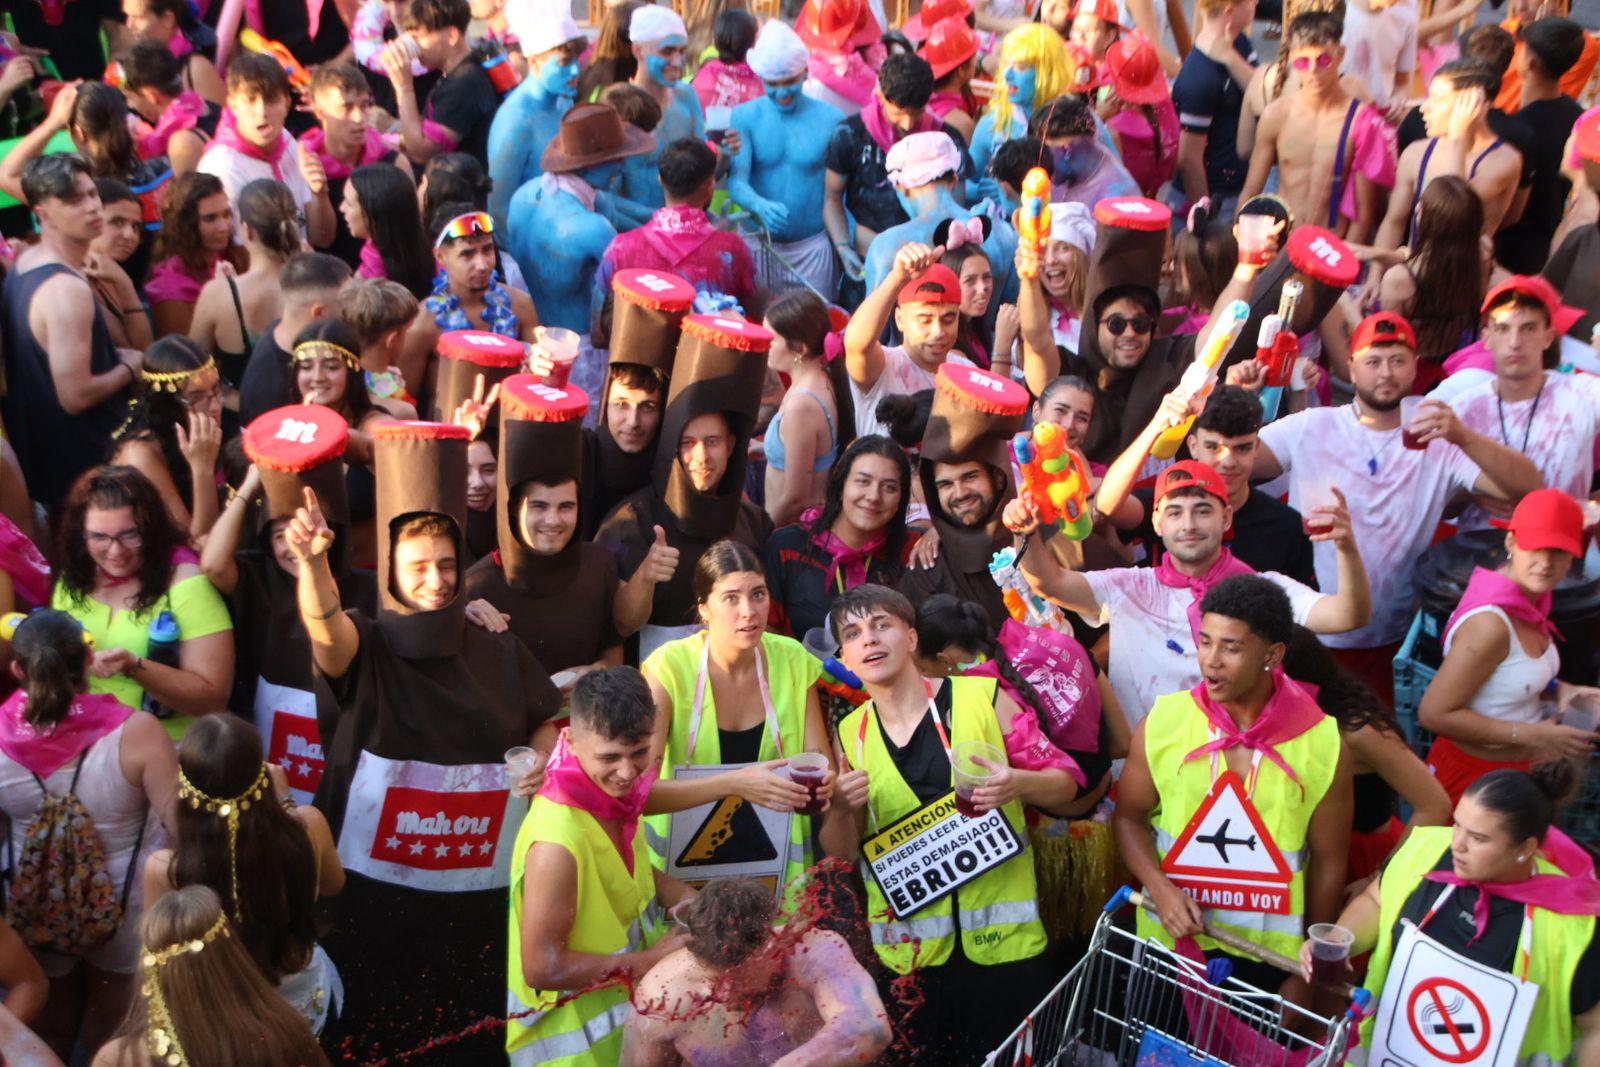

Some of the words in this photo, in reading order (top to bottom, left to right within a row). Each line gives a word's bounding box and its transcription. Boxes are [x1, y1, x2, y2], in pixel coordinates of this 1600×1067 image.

[396, 811, 491, 836] Mahou
[889, 799, 956, 846] ATENCIÓN
[875, 861, 886, 873] SI
[886, 838, 928, 867] PUEDES
[928, 820, 959, 842] LEER
[882, 861, 921, 890] ESTAS
[922, 816, 1000, 867] DEMASIADO
[890, 826, 1014, 912] EBRIO!!!
[1181, 887, 1245, 907] OLANDO
[1250, 892, 1282, 910] VOY
[974, 930, 1002, 946] BMW
